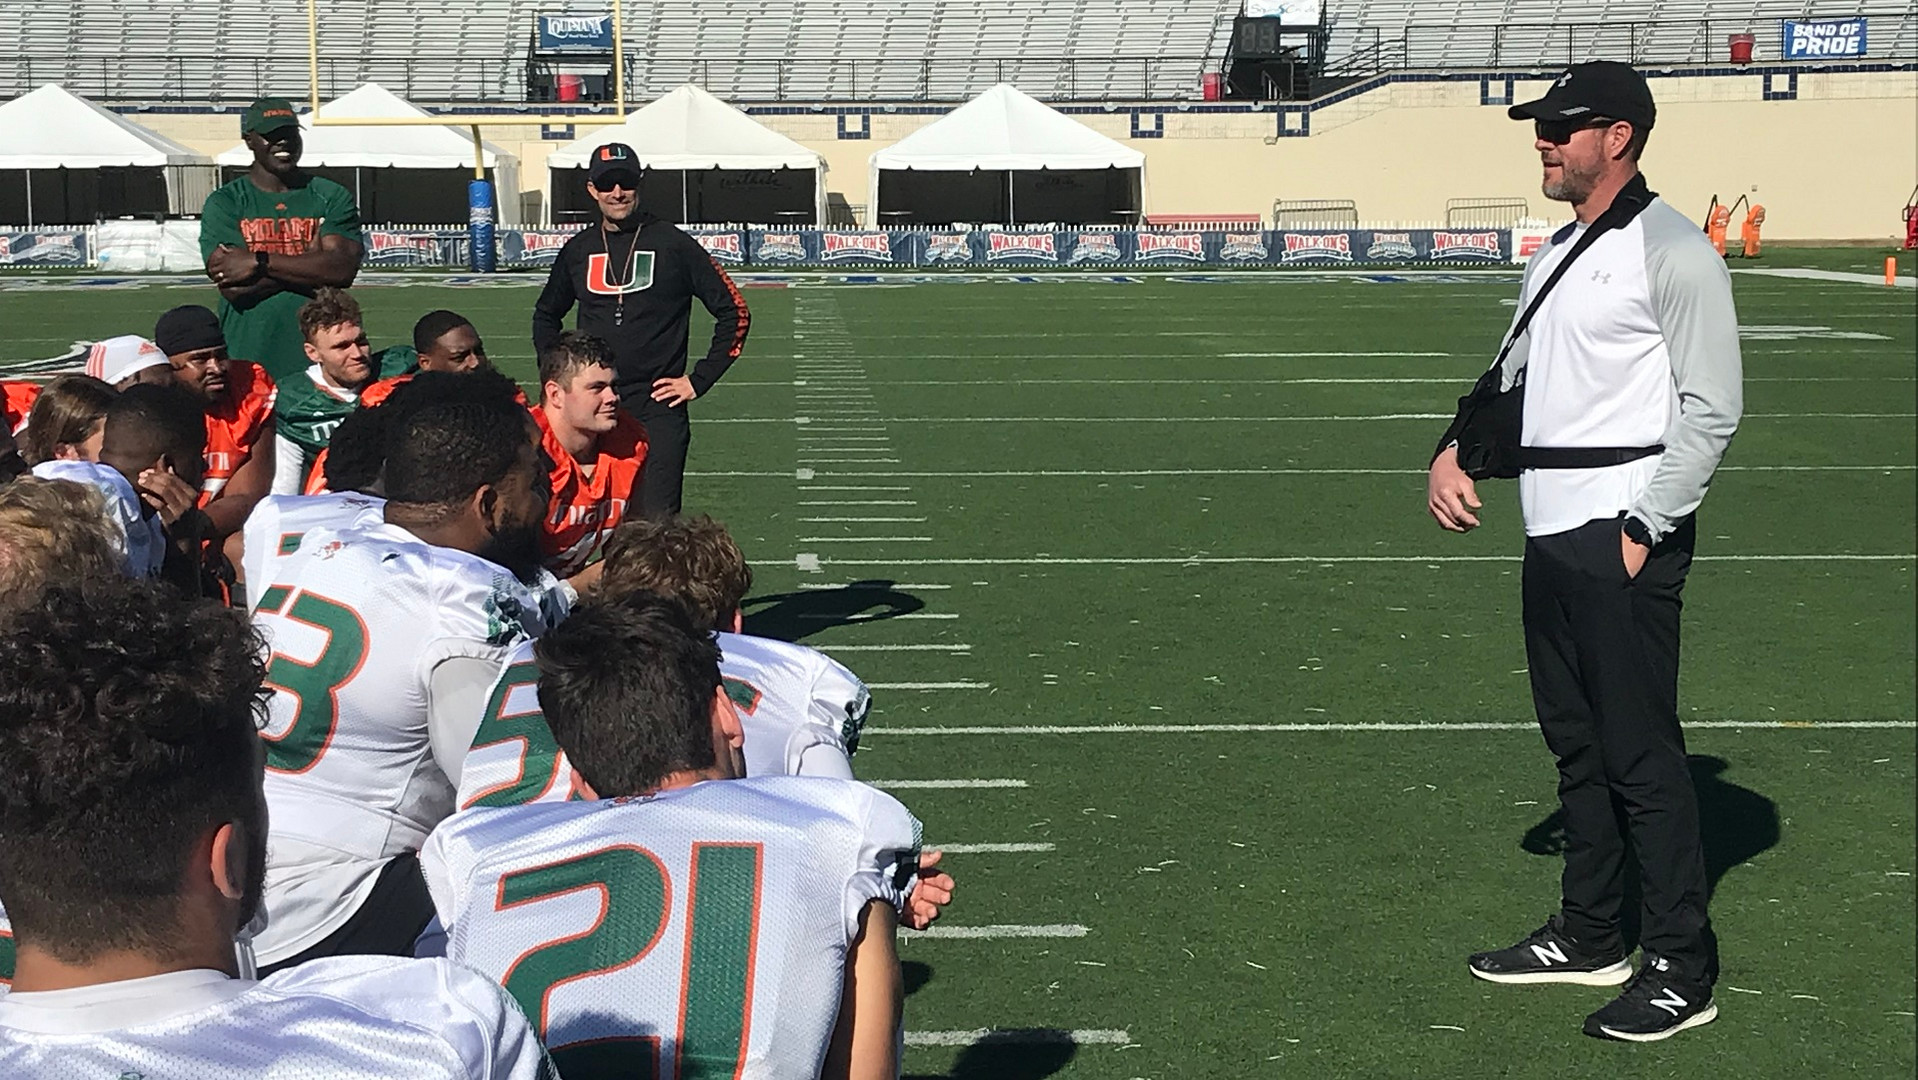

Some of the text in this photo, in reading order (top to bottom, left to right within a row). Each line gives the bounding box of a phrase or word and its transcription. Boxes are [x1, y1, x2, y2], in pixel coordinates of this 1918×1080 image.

[547, 15, 609, 39] LOUISIANA
[1793, 24, 1861, 37] BAND OF
[1791, 37, 1860, 55] PRIDE
[601, 147, 627, 161] U
[240, 217, 318, 242] MIAM
[586, 251, 655, 295] U
[495, 841, 764, 1080] 21
[1530, 941, 1569, 966] N
[1650, 988, 1688, 1017] N
